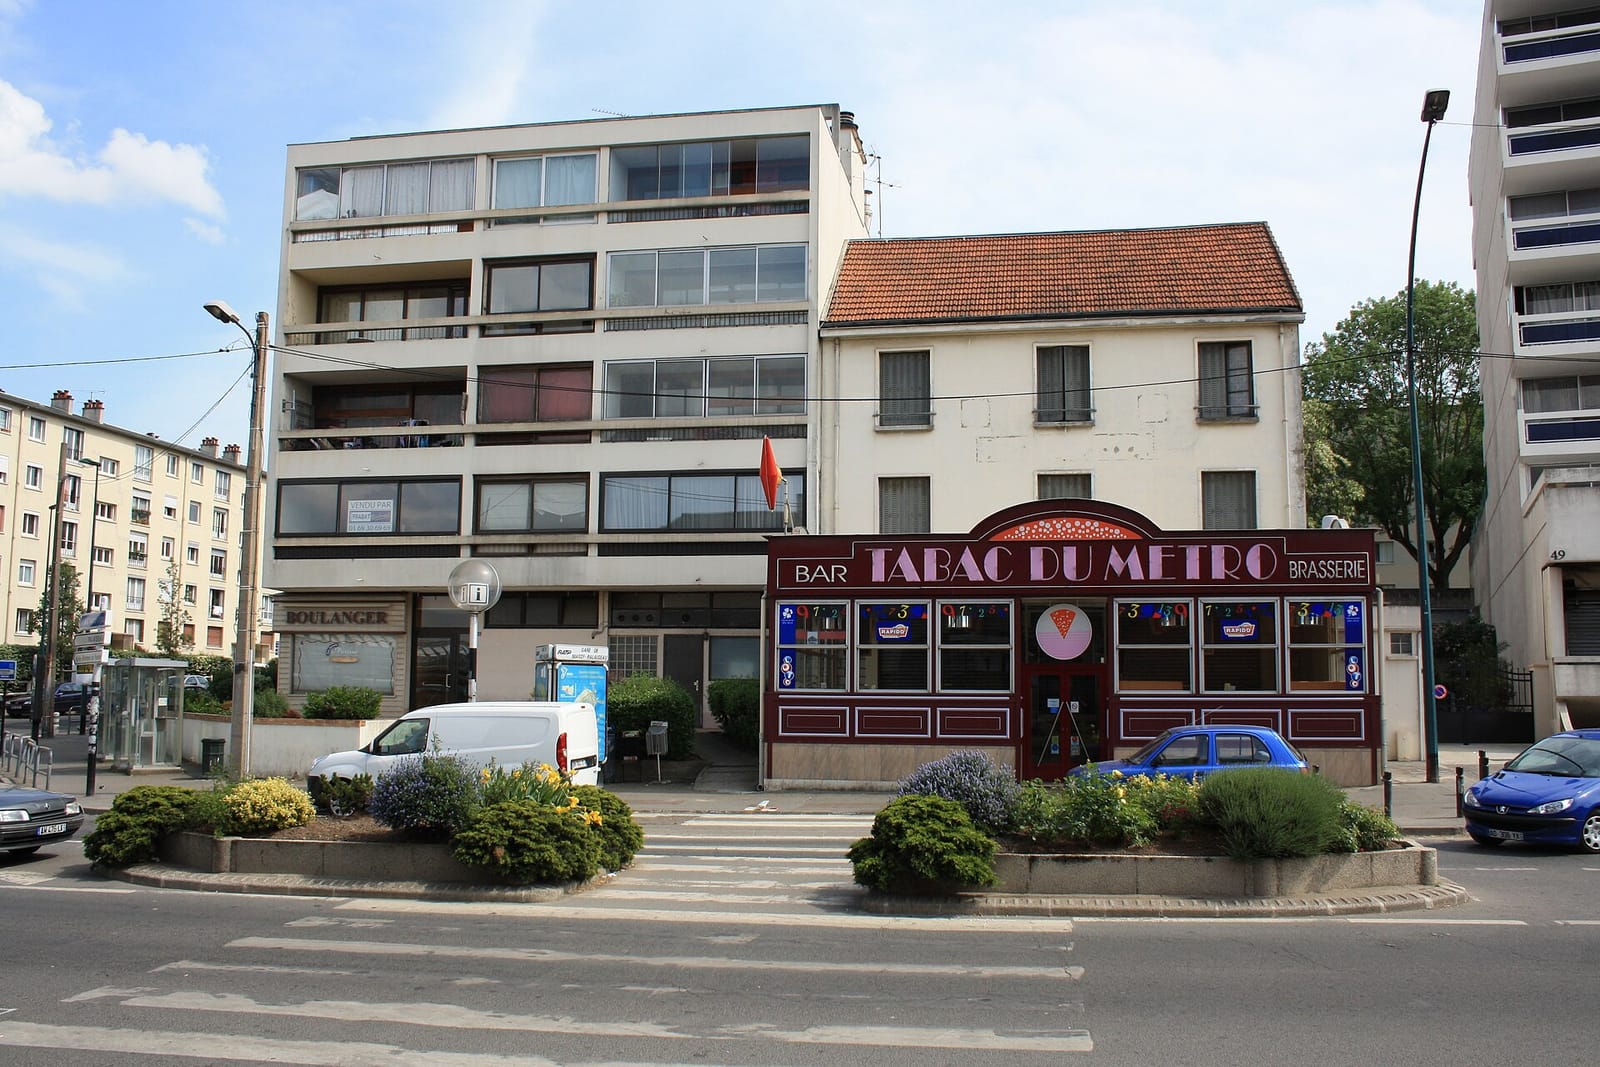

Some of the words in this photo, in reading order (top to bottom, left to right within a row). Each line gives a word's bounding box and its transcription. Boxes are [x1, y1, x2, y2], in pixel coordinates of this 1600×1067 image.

[350, 501, 376, 509] VENDU
[1550, 549, 1565, 560] 49
[864, 545, 1014, 583] TABAC
[1030, 545, 1092, 581] DU
[1104, 543, 1278, 581] METRO
[1289, 559, 1365, 579] BRASSERIE
[795, 565, 848, 583] BAR
[286, 611, 388, 625] BOULANGER
